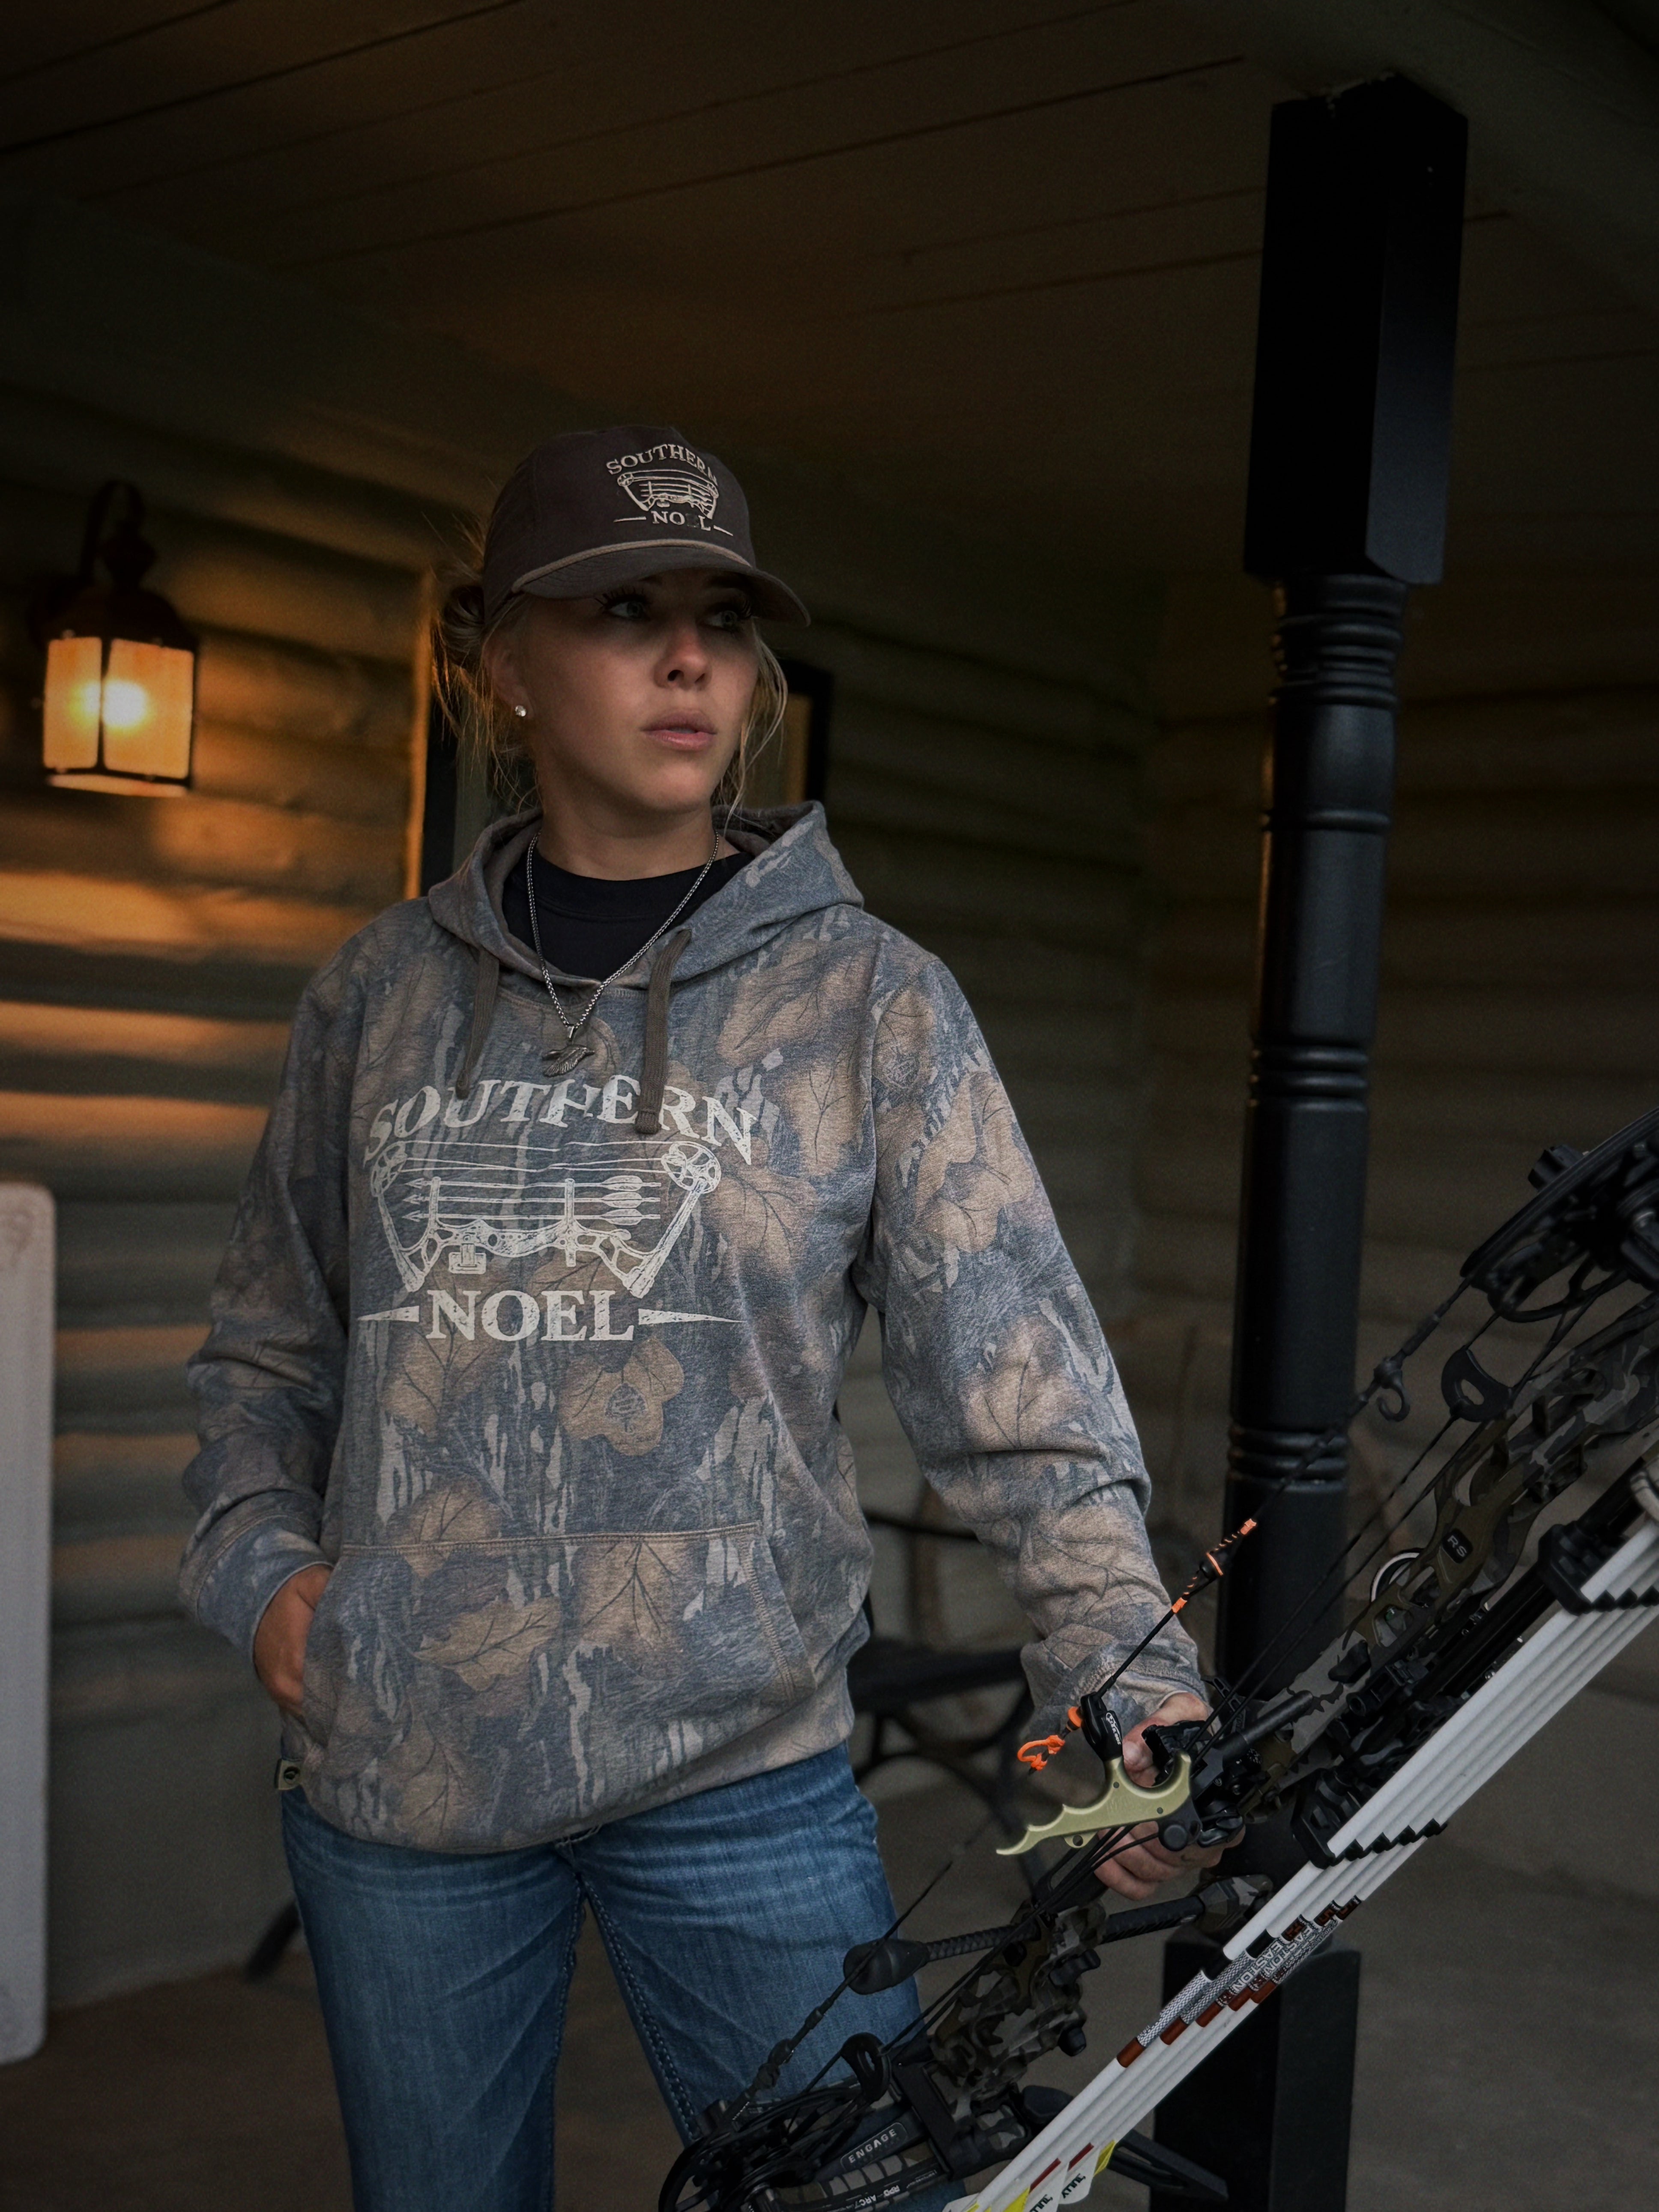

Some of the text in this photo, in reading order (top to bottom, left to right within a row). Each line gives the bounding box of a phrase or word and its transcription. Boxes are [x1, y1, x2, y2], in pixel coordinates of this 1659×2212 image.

[651, 511, 711, 531] NOL
[363, 1074, 758, 1166] SOUTHERN
[426, 1290, 635, 1342] NOEL
[1232, 1943, 1283, 1993] EASTON
[1264, 1928, 1310, 1975] EASTON
[848, 2128, 897, 2164] ENGAGE
